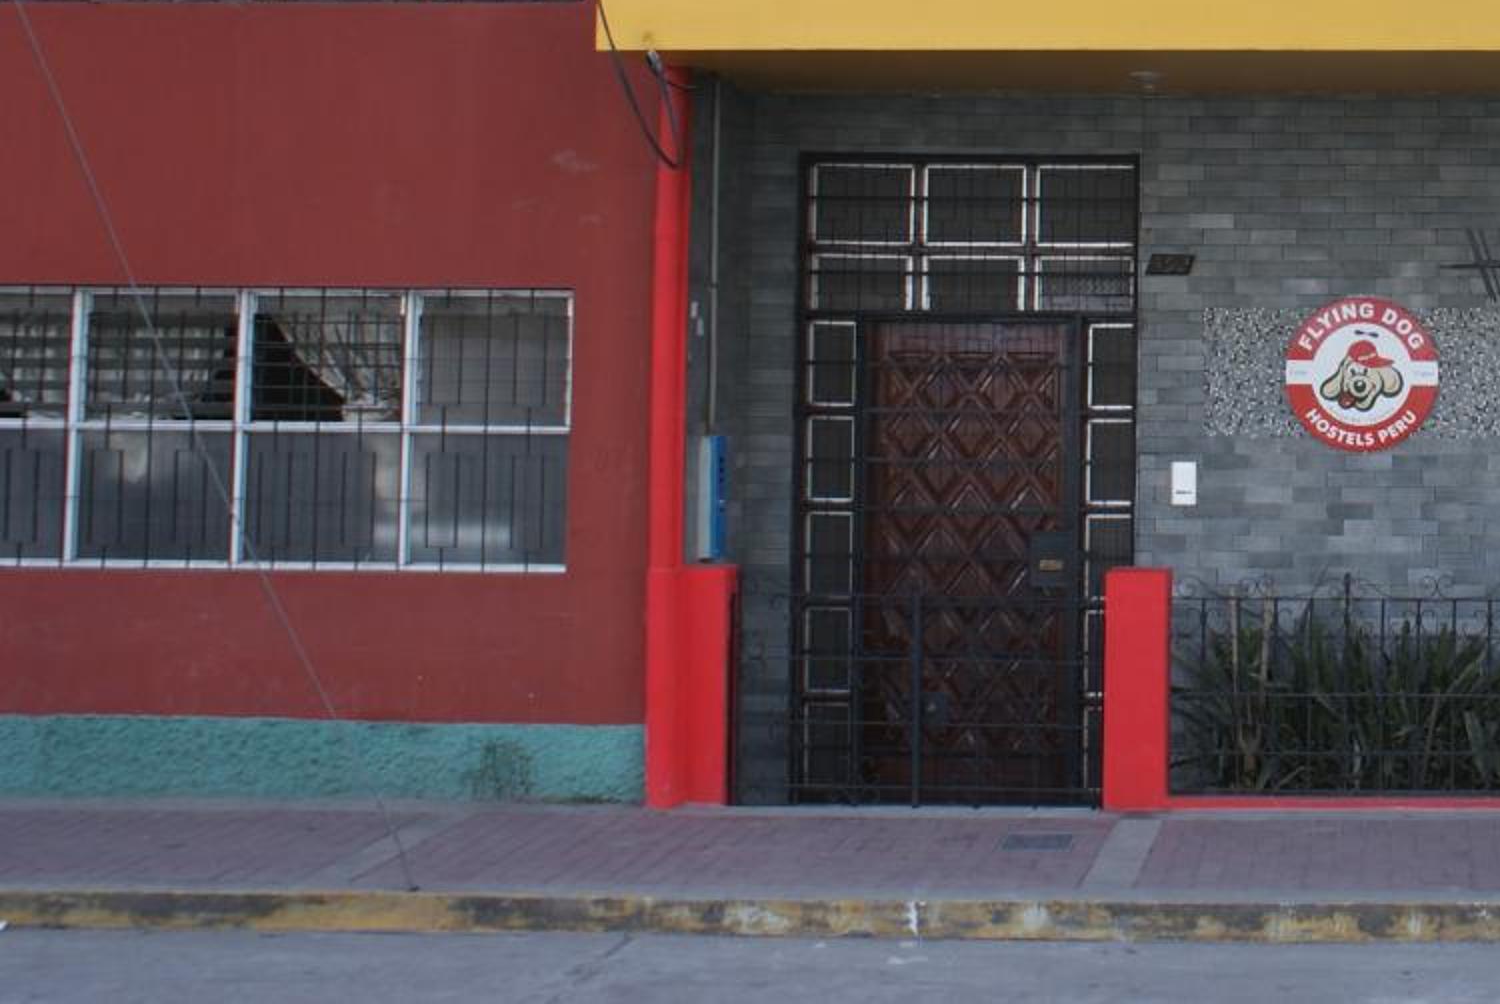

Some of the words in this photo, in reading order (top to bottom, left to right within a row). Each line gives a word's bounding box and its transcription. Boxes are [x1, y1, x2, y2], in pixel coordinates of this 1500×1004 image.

[1299, 303, 1375, 351] FLYING
[1381, 308, 1425, 350] DOG
[1305, 408, 1376, 446] HOSTELS
[1378, 409, 1418, 444] PERU
